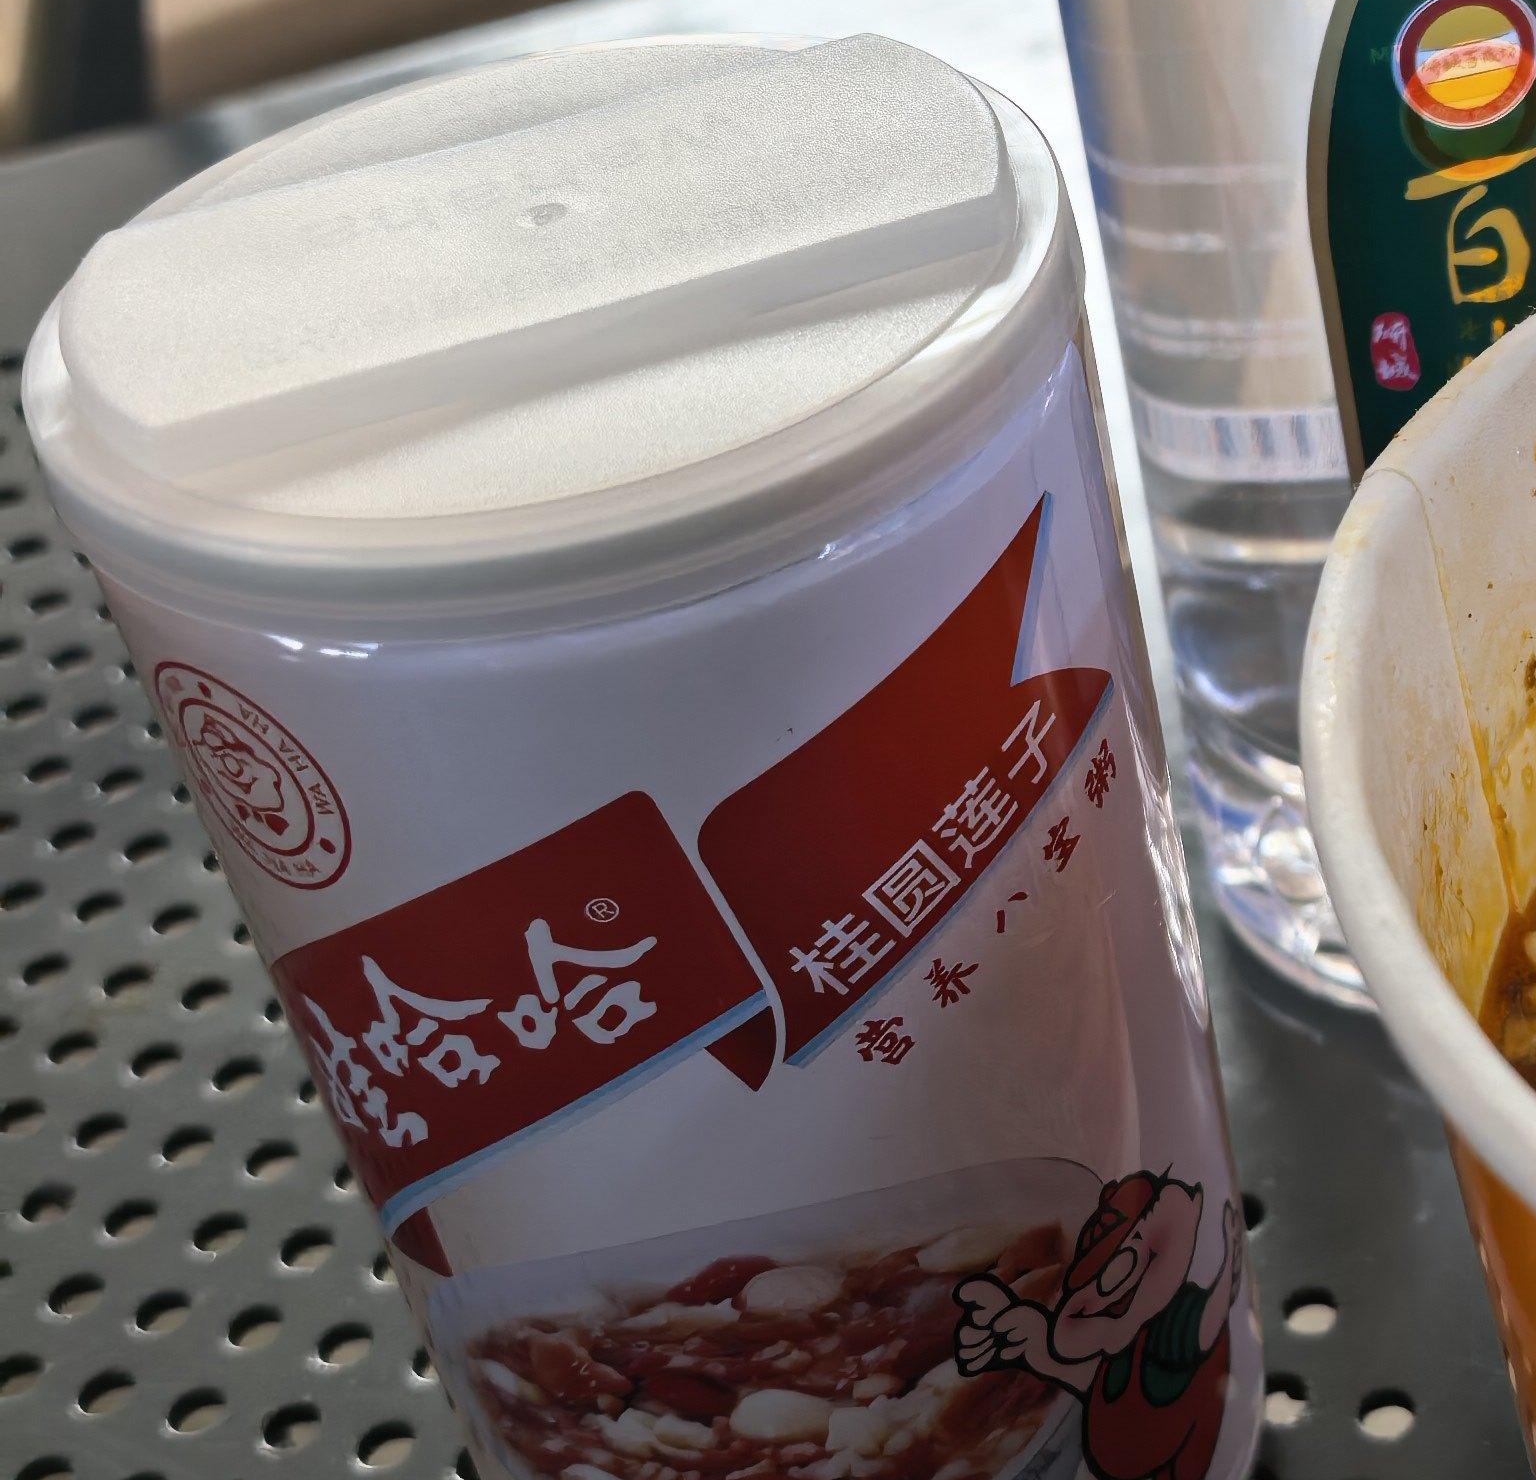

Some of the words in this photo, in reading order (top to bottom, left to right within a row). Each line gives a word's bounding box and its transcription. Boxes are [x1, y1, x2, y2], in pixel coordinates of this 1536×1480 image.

[788, 699, 1058, 997] 桂圆莲子
[854, 737, 1117, 1067] 营养八宝粥
